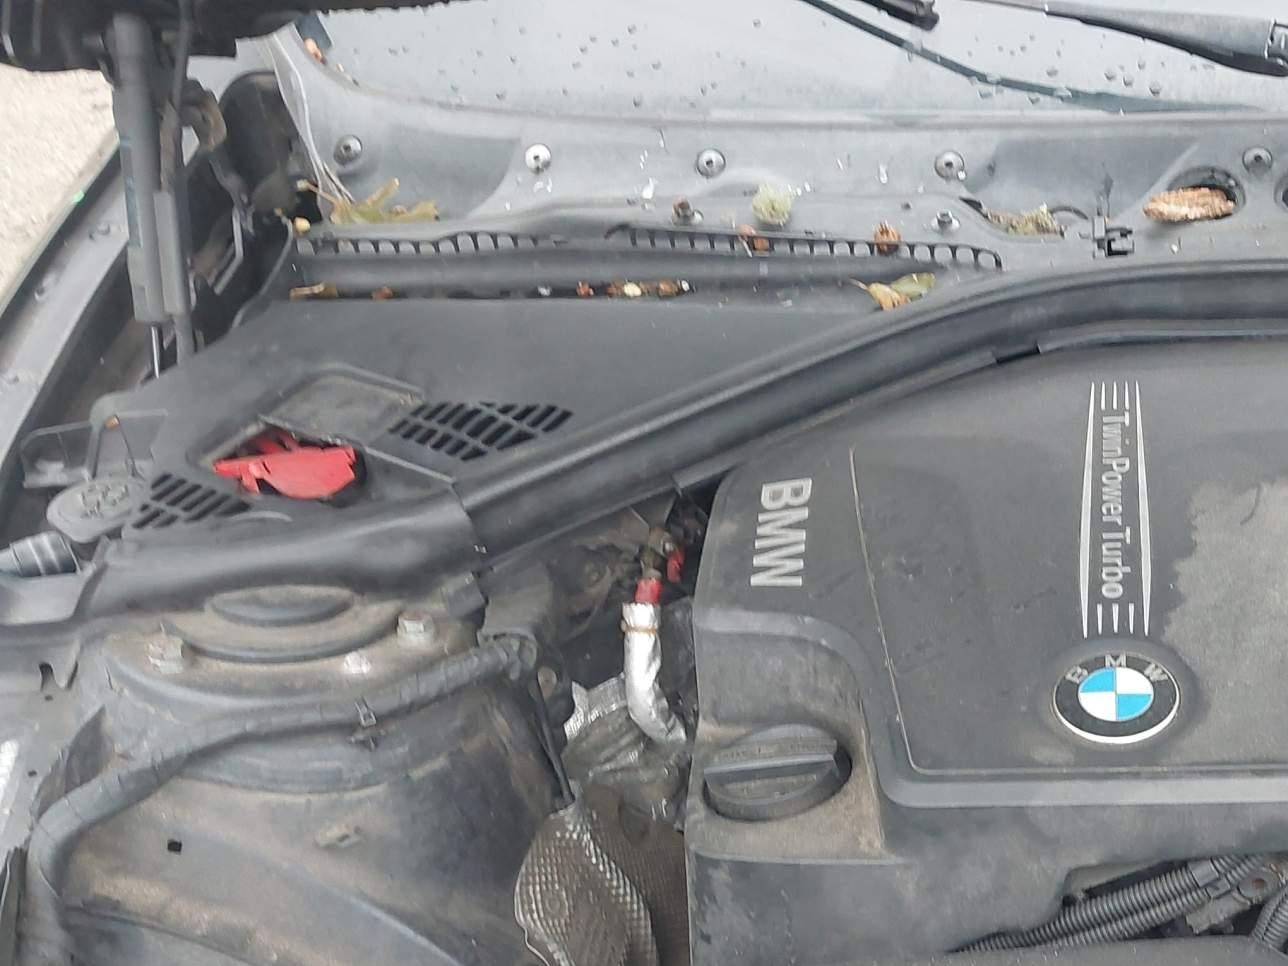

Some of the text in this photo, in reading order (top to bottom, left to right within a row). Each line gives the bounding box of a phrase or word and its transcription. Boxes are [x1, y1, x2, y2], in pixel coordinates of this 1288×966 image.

[750, 478, 812, 587] BMW
[1101, 411, 1131, 599] TwinPower Turbo
[1065, 650, 1169, 684] BMW
